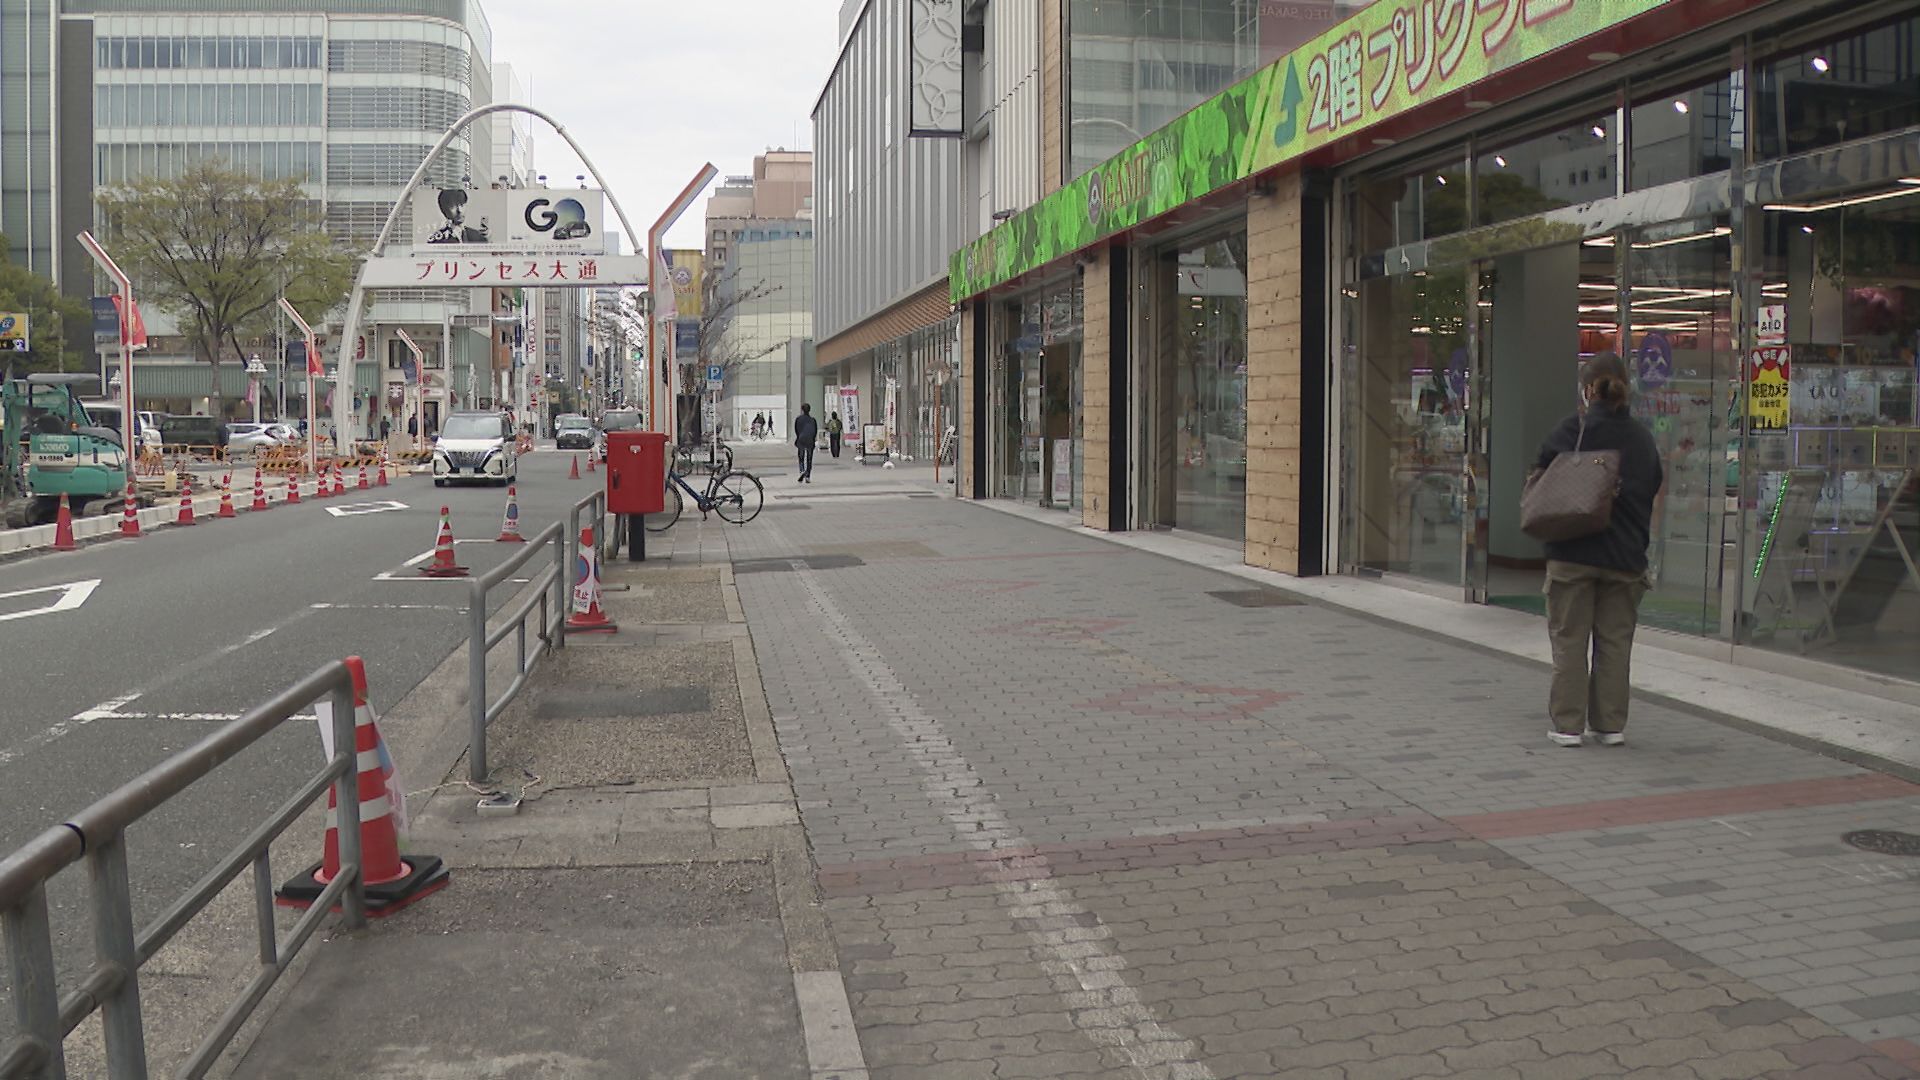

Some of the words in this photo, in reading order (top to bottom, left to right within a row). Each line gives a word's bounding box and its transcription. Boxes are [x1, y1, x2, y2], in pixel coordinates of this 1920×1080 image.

[415, 258, 598, 281] プリンセス大通
[1760, 319, 1782, 332] AED
[711, 367, 720, 380] P
[1751, 383, 1789, 398] 防犯カメラ
